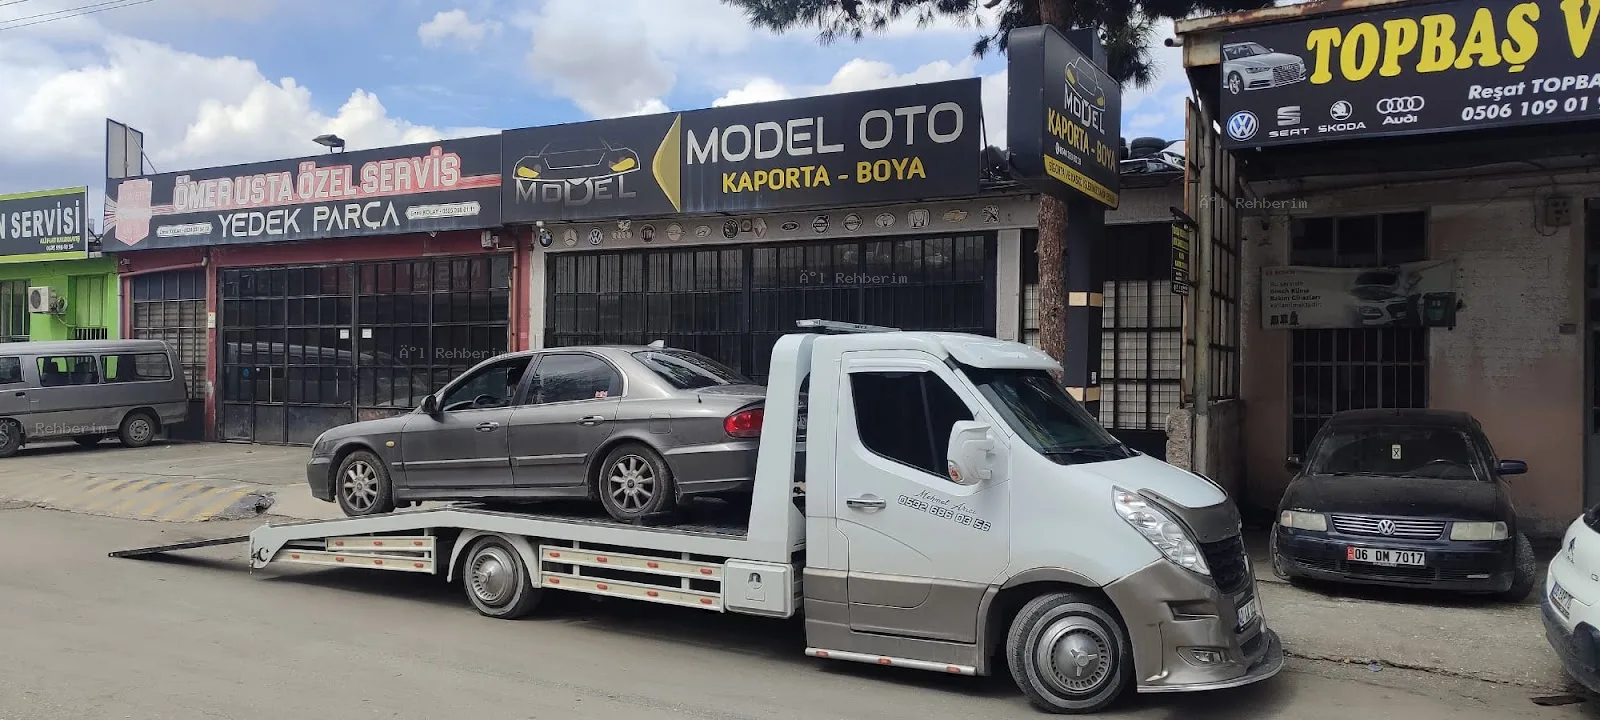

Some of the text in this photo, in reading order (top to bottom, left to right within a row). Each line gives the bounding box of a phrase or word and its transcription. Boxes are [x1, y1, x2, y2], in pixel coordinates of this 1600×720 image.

[1306, 2, 1541, 84] TOPBAŞ
[1064, 83, 1105, 135] MODEL
[1461, 96, 1589, 121] 0506 109 01
[1467, 82, 1526, 101] Reşat
[687, 102, 964, 165] MODEL OTO
[1268, 127, 1311, 138] SEAT
[1318, 121, 1367, 133] SKODA
[1381, 115, 1418, 125] Audi
[1047, 107, 1091, 156] KAPORTA
[1096, 140, 1116, 172] BOYA
[174, 175, 233, 212] ÖMER
[234, 172, 293, 206] USTA
[299, 161, 357, 198] ÖZEL
[361, 147, 461, 194] SERVİS
[515, 175, 637, 206] MODEL
[721, 165, 830, 194] KAPORTA
[856, 156, 926, 184] BOYA
[11, 200, 80, 239] SERVİSİ
[218, 201, 400, 238] YEDEK PARÇA
[897, 494, 992, 531] 0532 686 03 56
[1355, 549, 1423, 563] 06 DM 7017
